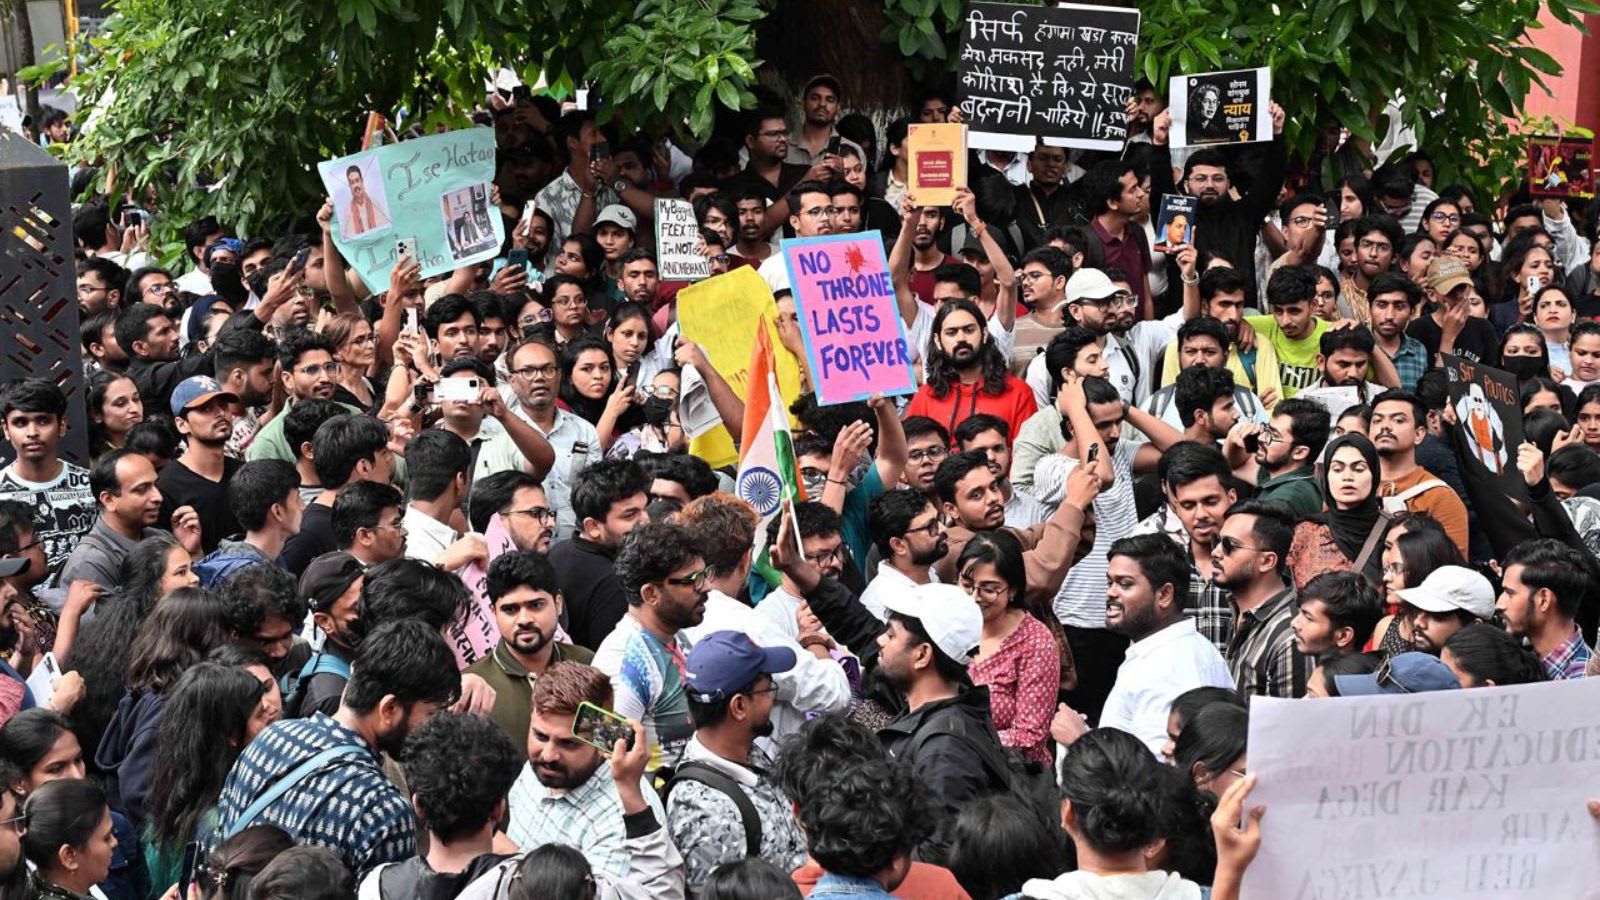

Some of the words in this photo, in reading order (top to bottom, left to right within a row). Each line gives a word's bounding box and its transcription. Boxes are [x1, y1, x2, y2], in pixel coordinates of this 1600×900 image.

[966, 10, 1027, 43] सिर्फ
[1034, 20, 1075, 43] हंगामा
[988, 48, 1045, 71] मकसद
[1094, 46, 1125, 73] मेरी
[1029, 71, 1048, 97] है
[1052, 72, 1075, 99] कि
[1080, 71, 1098, 99] ये
[960, 95, 1032, 125] बदलनी
[1223, 103, 1252, 116] न्याय
[661, 222, 686, 238] FLEX
[675, 241, 693, 255] NOT
[798, 250, 831, 276] NO
[817, 272, 896, 301] THRONE
[812, 305, 881, 336] LASTS
[820, 338, 912, 381] FOREVER
